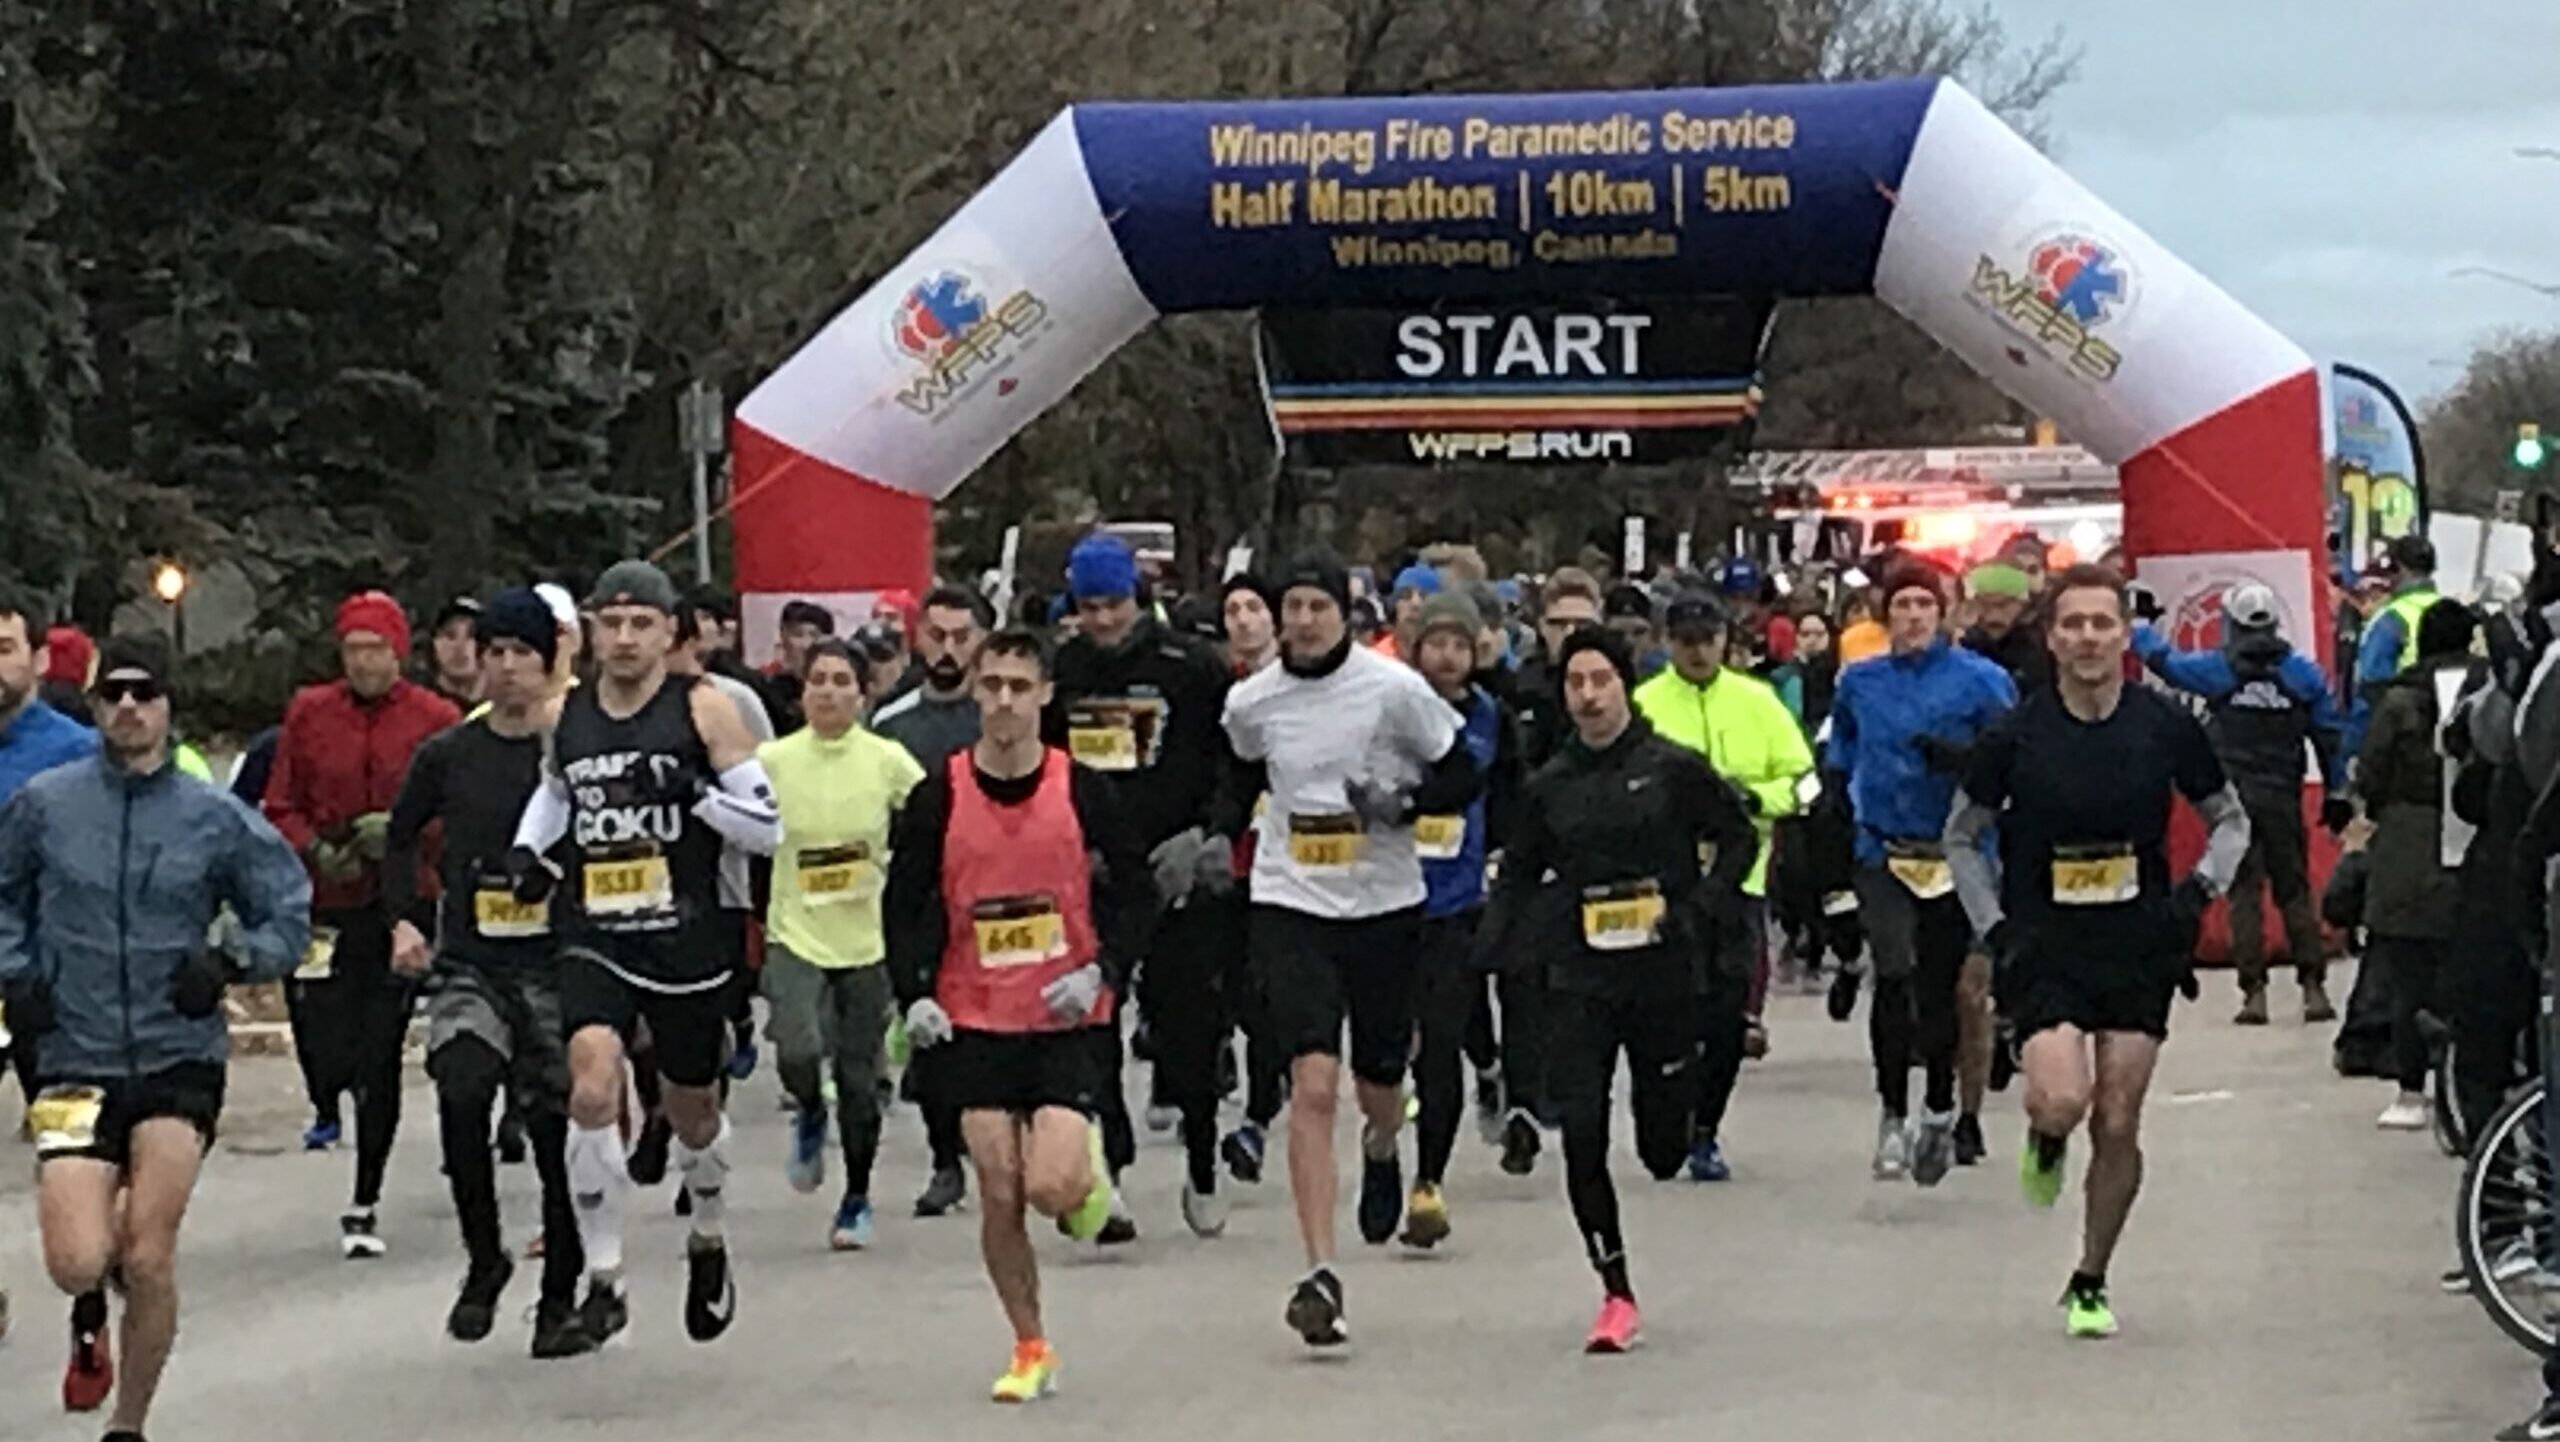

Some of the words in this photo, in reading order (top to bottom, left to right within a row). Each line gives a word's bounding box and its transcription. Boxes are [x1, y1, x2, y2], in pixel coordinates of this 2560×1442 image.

[1211, 120, 1376, 176] Winnipeg
[1386, 118, 1454, 162] Fire
[1463, 110, 1652, 159] Paramedic
[1662, 108, 1796, 153] Service
[1211, 179, 1295, 229] Half
[1307, 175, 1497, 225] Marathon
[1545, 168, 1656, 219] 10km
[1704, 164, 1791, 213] 5km
[1533, 228, 1678, 263] Canada
[1396, 314, 1652, 378] START
[1972, 251, 2122, 382] WFPS
[895, 289, 1048, 414] WFPS
[574, 803, 683, 846] GOKU
